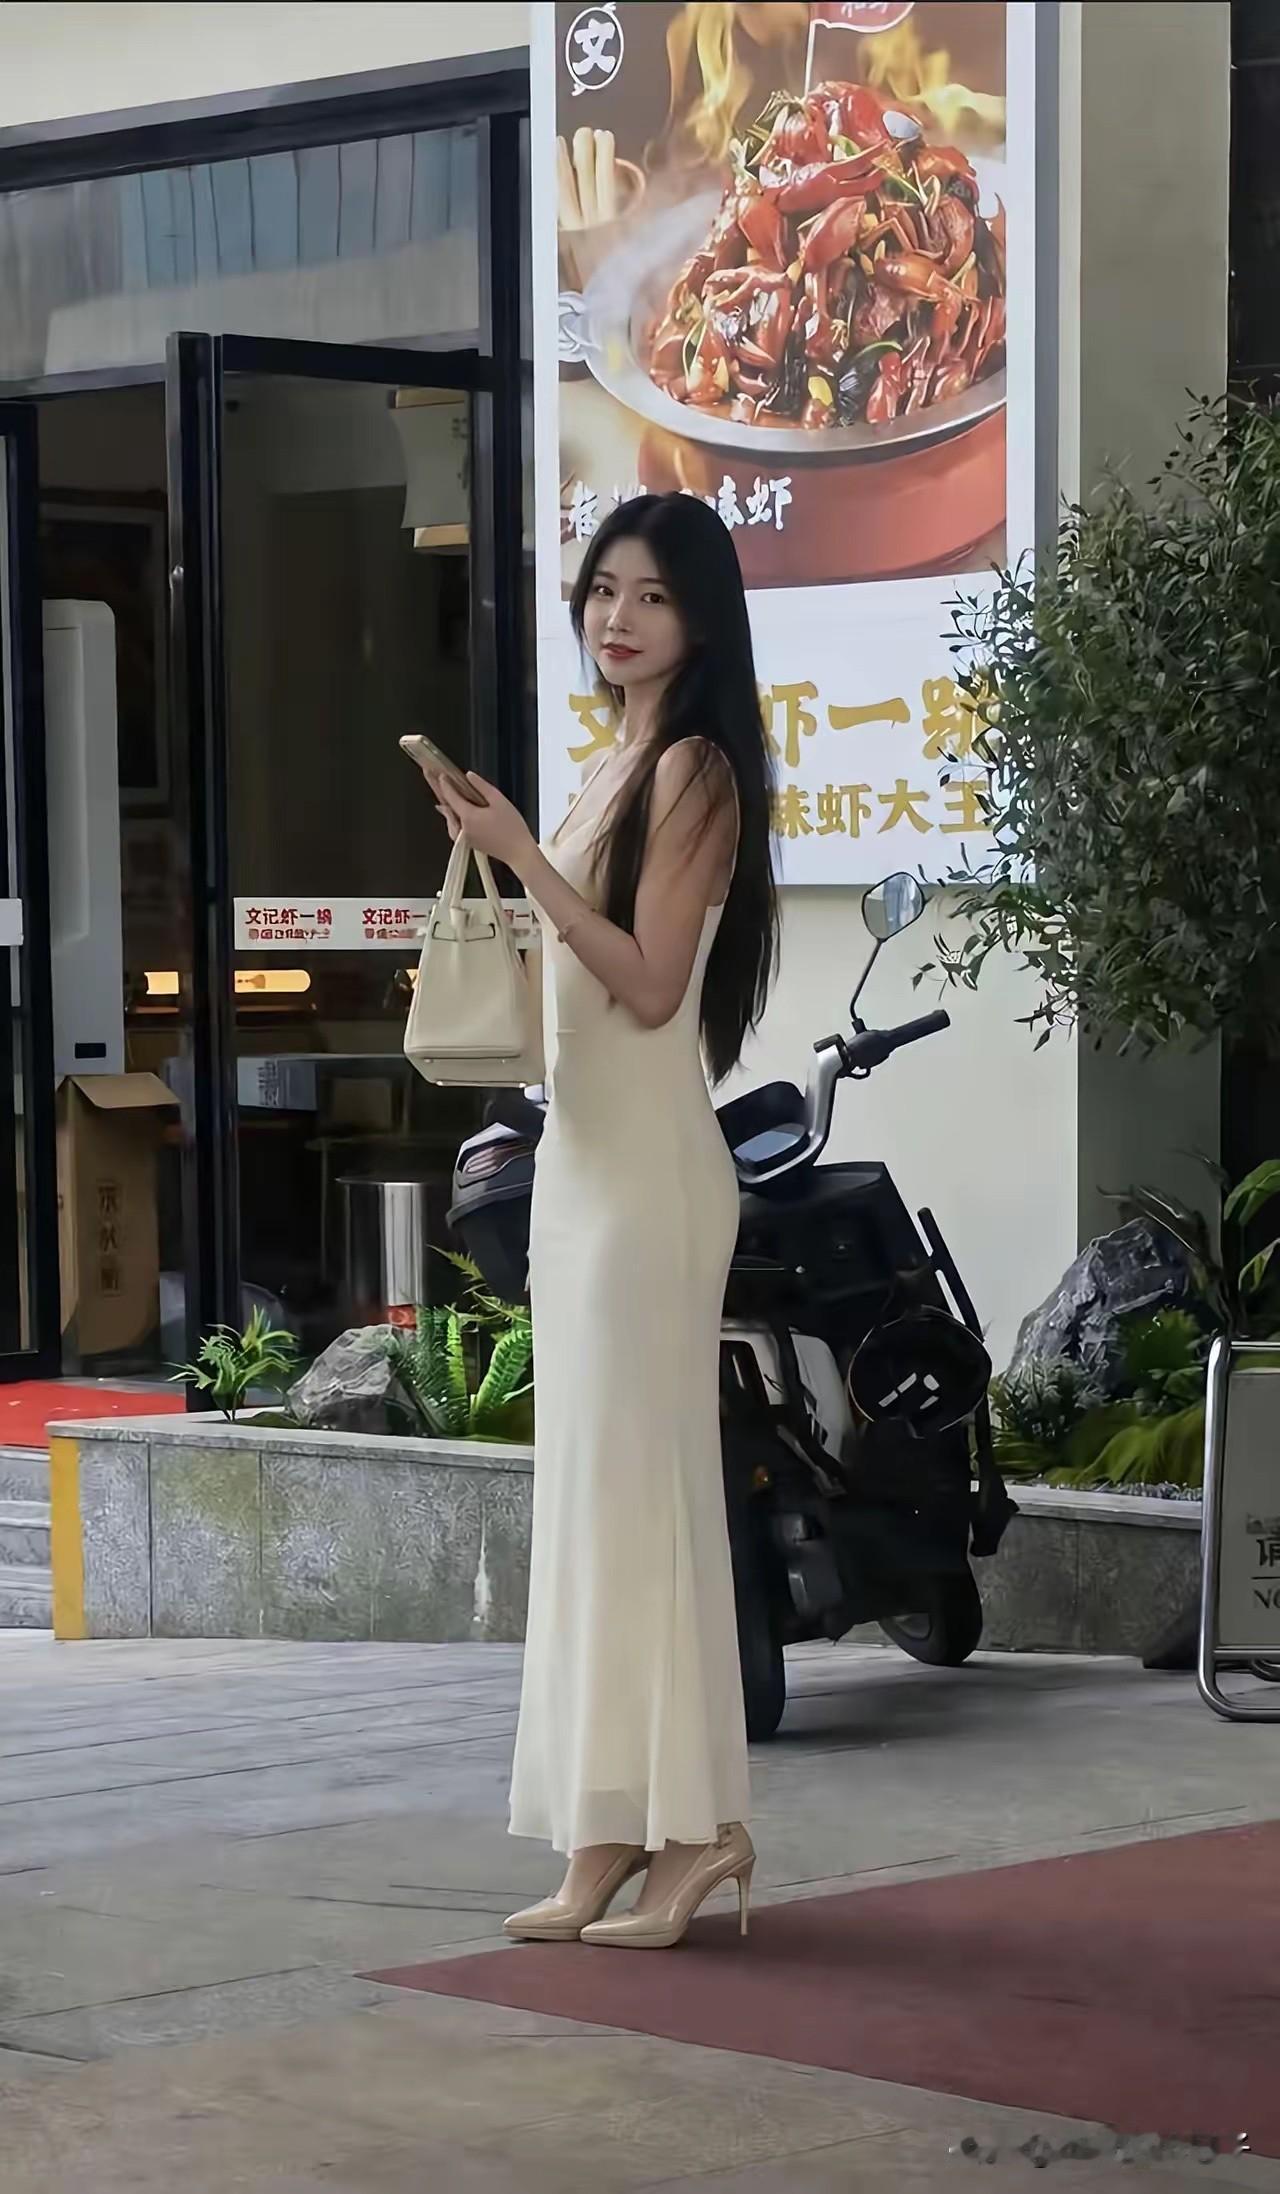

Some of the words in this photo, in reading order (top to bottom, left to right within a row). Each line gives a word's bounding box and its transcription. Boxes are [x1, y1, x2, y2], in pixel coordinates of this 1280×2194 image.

[572, 17, 616, 76] 文
[566, 676, 992, 764] 文虾一
[362, 907, 431, 925] 文记虾一
